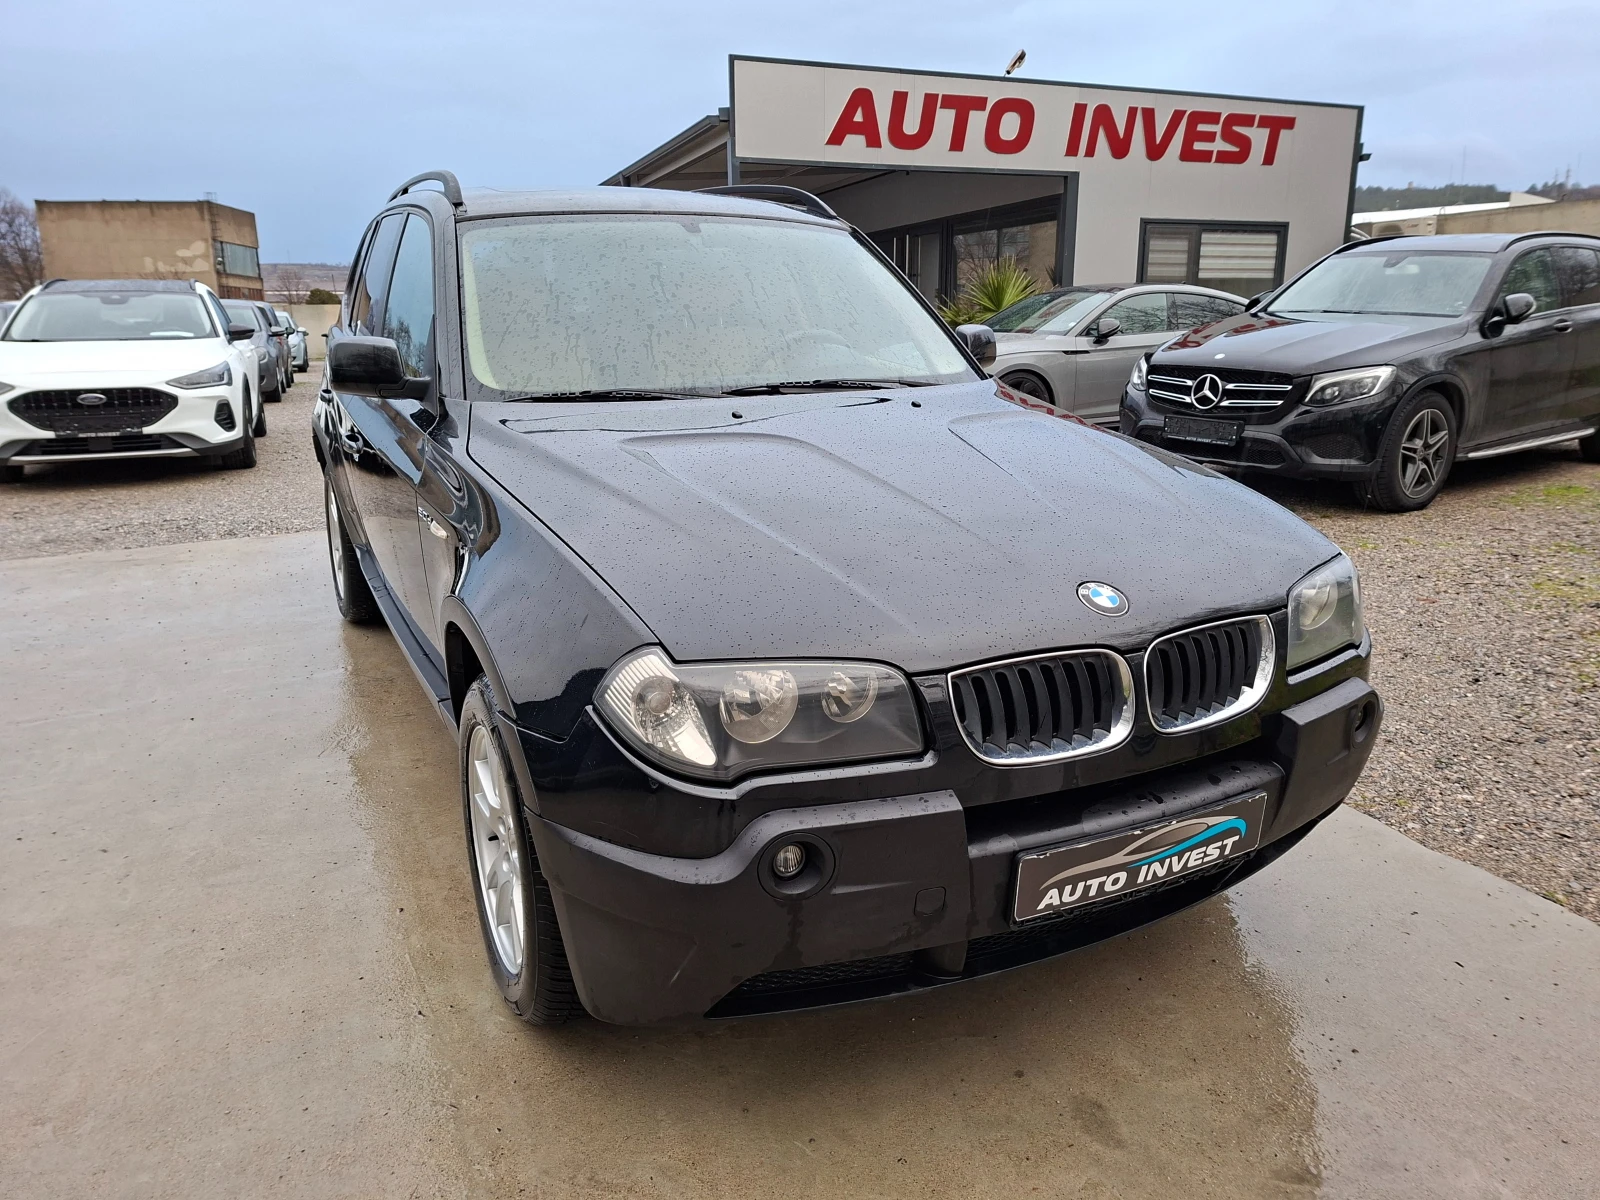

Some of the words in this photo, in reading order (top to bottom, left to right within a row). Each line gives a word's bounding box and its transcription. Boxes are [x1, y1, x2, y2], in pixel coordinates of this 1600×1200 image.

[825, 87, 1035, 154] AUTO
[1064, 102, 1297, 166] INVEST
[1036, 871, 1127, 910] AUTO
[1136, 835, 1240, 884] INVEST
